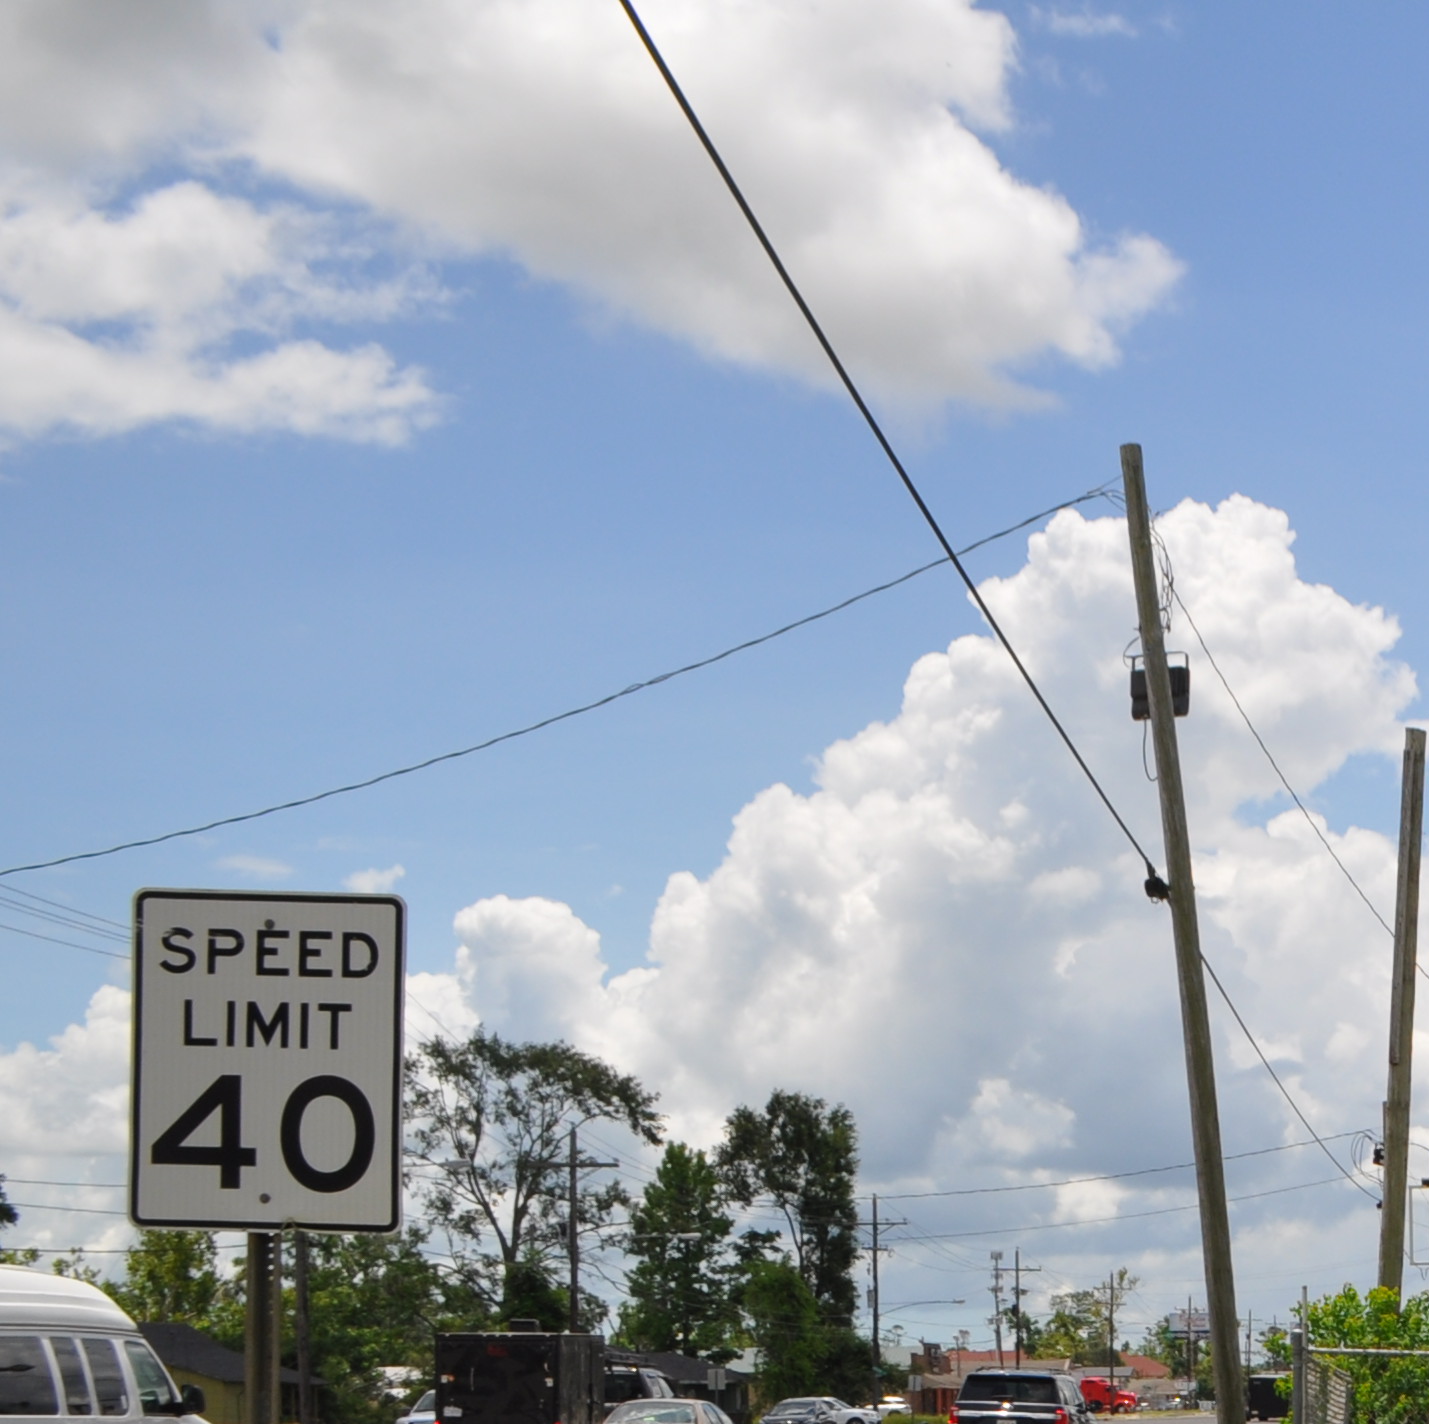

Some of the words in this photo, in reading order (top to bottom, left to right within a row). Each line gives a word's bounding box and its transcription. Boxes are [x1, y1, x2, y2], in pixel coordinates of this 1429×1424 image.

[160, 926, 379, 978] SPEED
[184, 999, 352, 1050] LIMIT
[151, 1074, 375, 1193] 40
